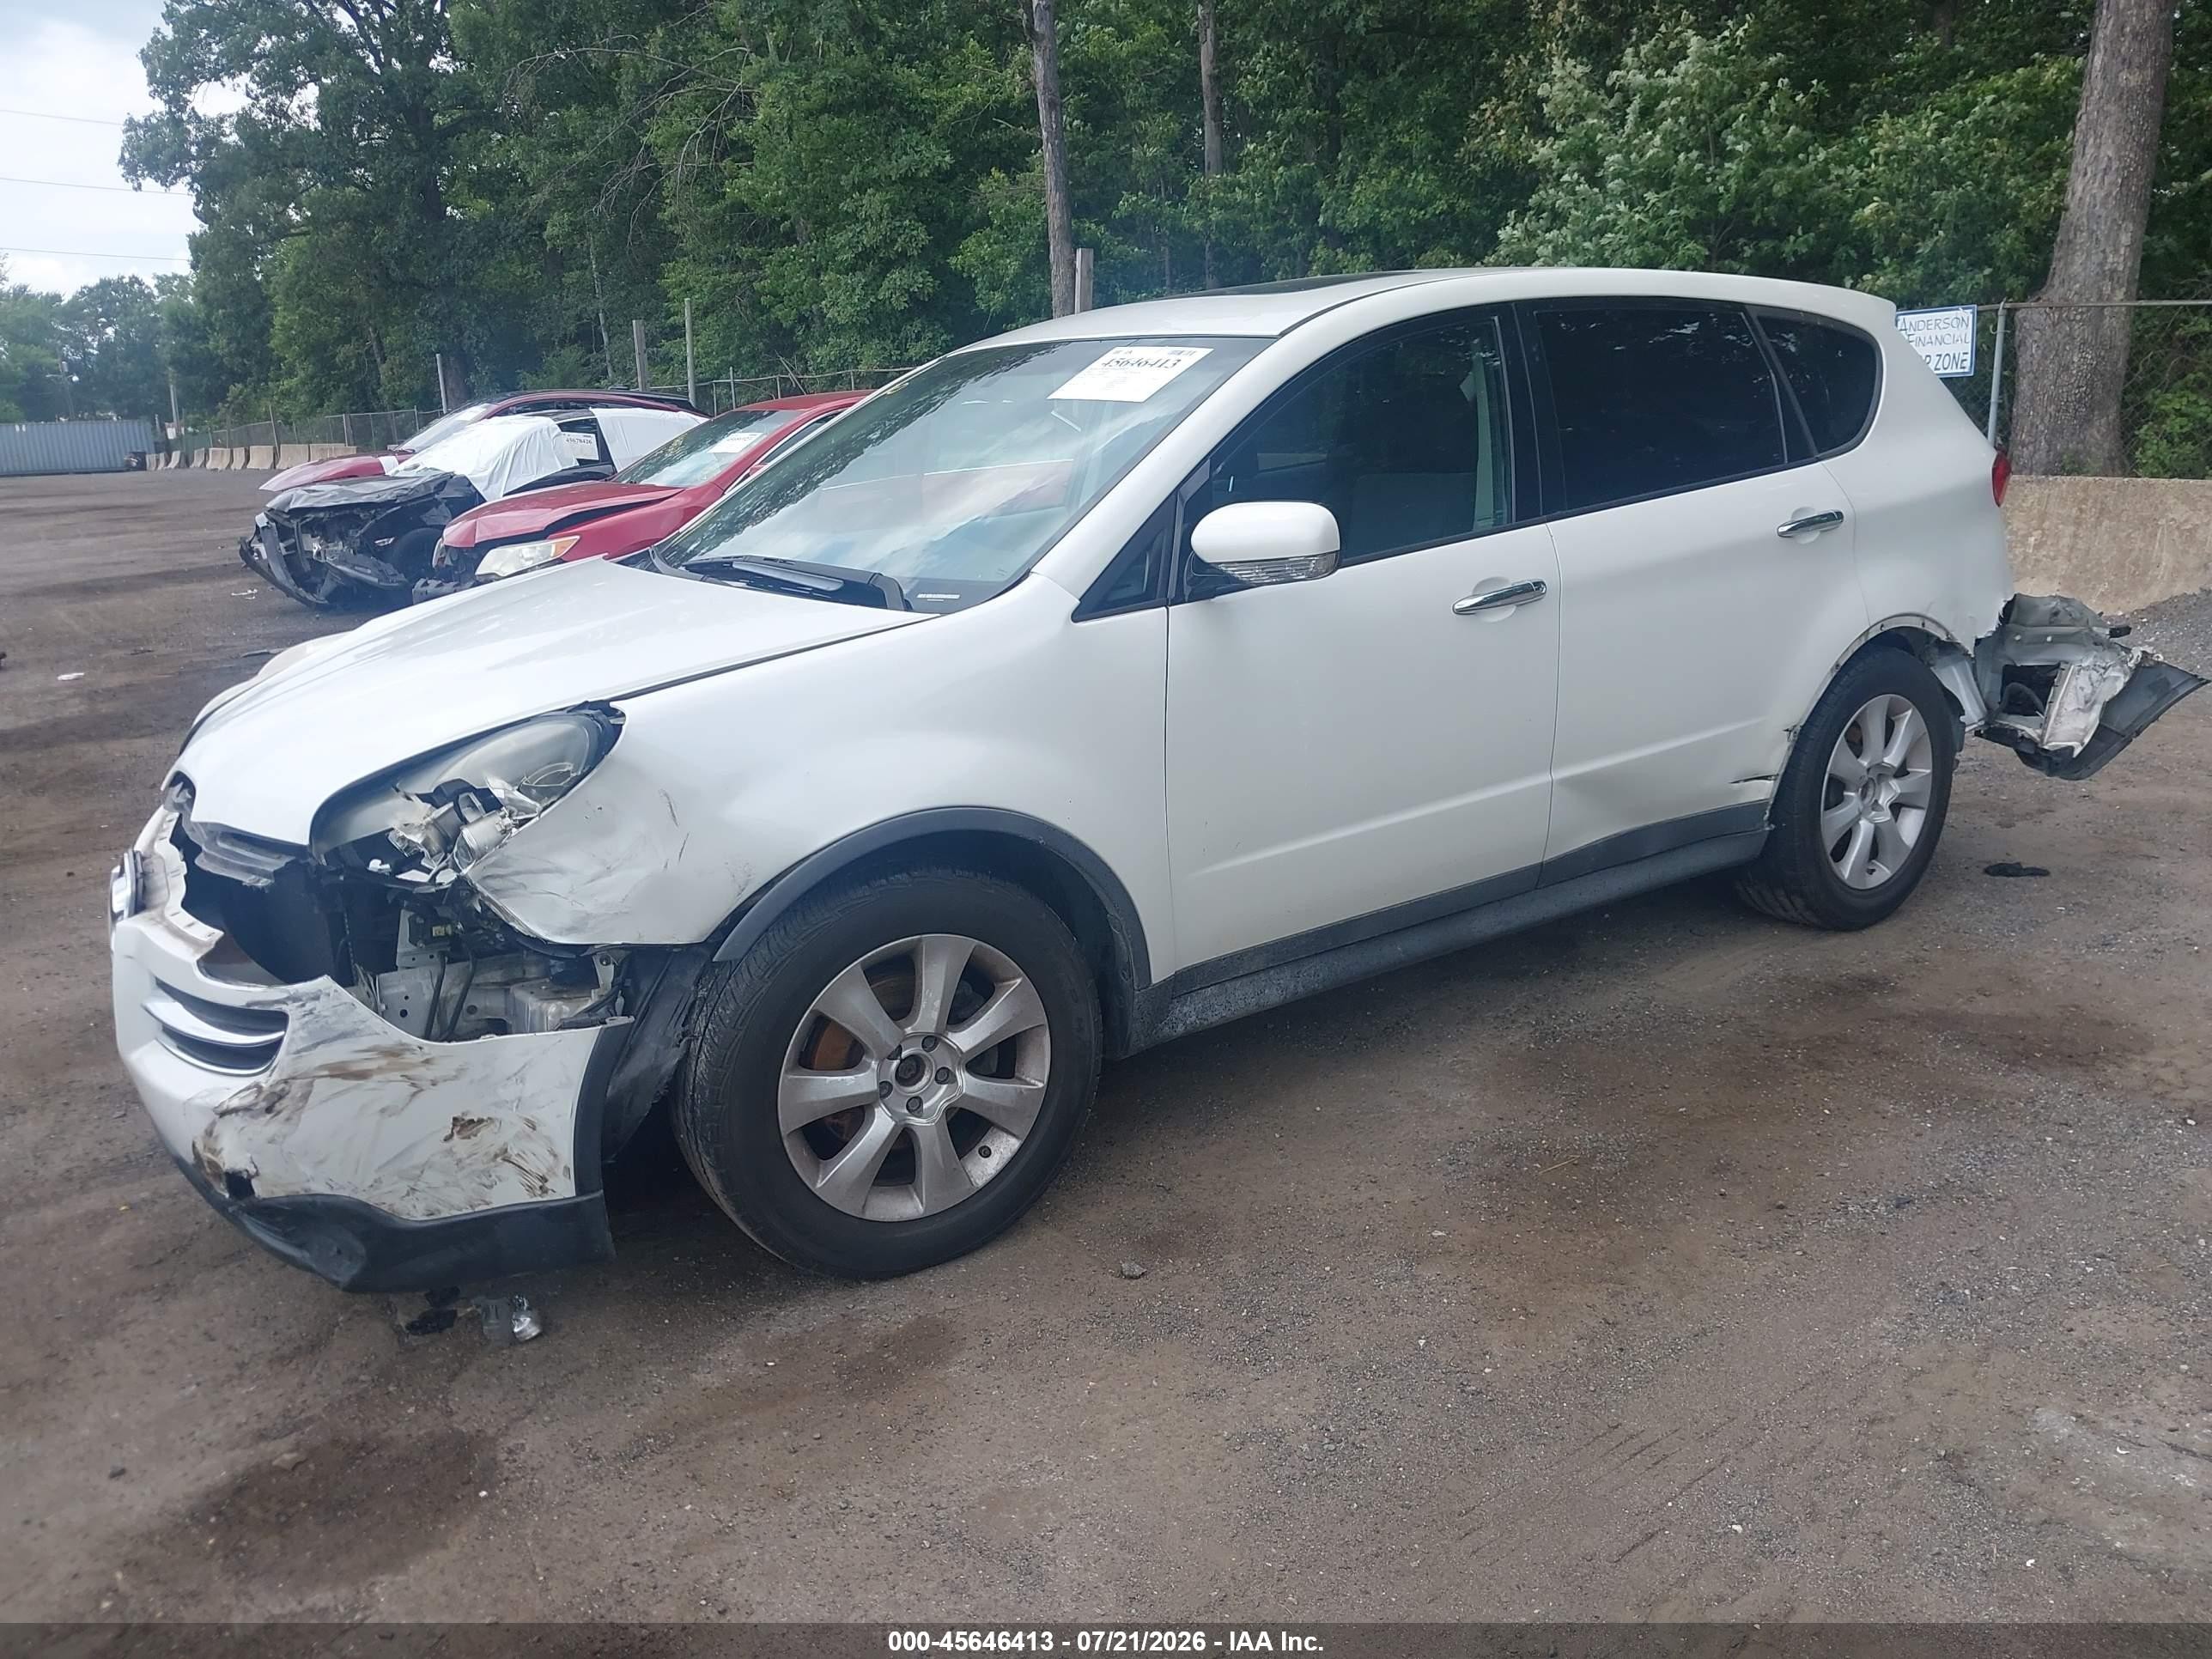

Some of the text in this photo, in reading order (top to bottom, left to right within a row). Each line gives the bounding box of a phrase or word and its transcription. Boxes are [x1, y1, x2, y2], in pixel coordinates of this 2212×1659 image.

[1899, 315, 1970, 332] ANDERSON
[1907, 332, 1970, 347] FINANCIAL
[1934, 352, 1969, 371] ZONE
